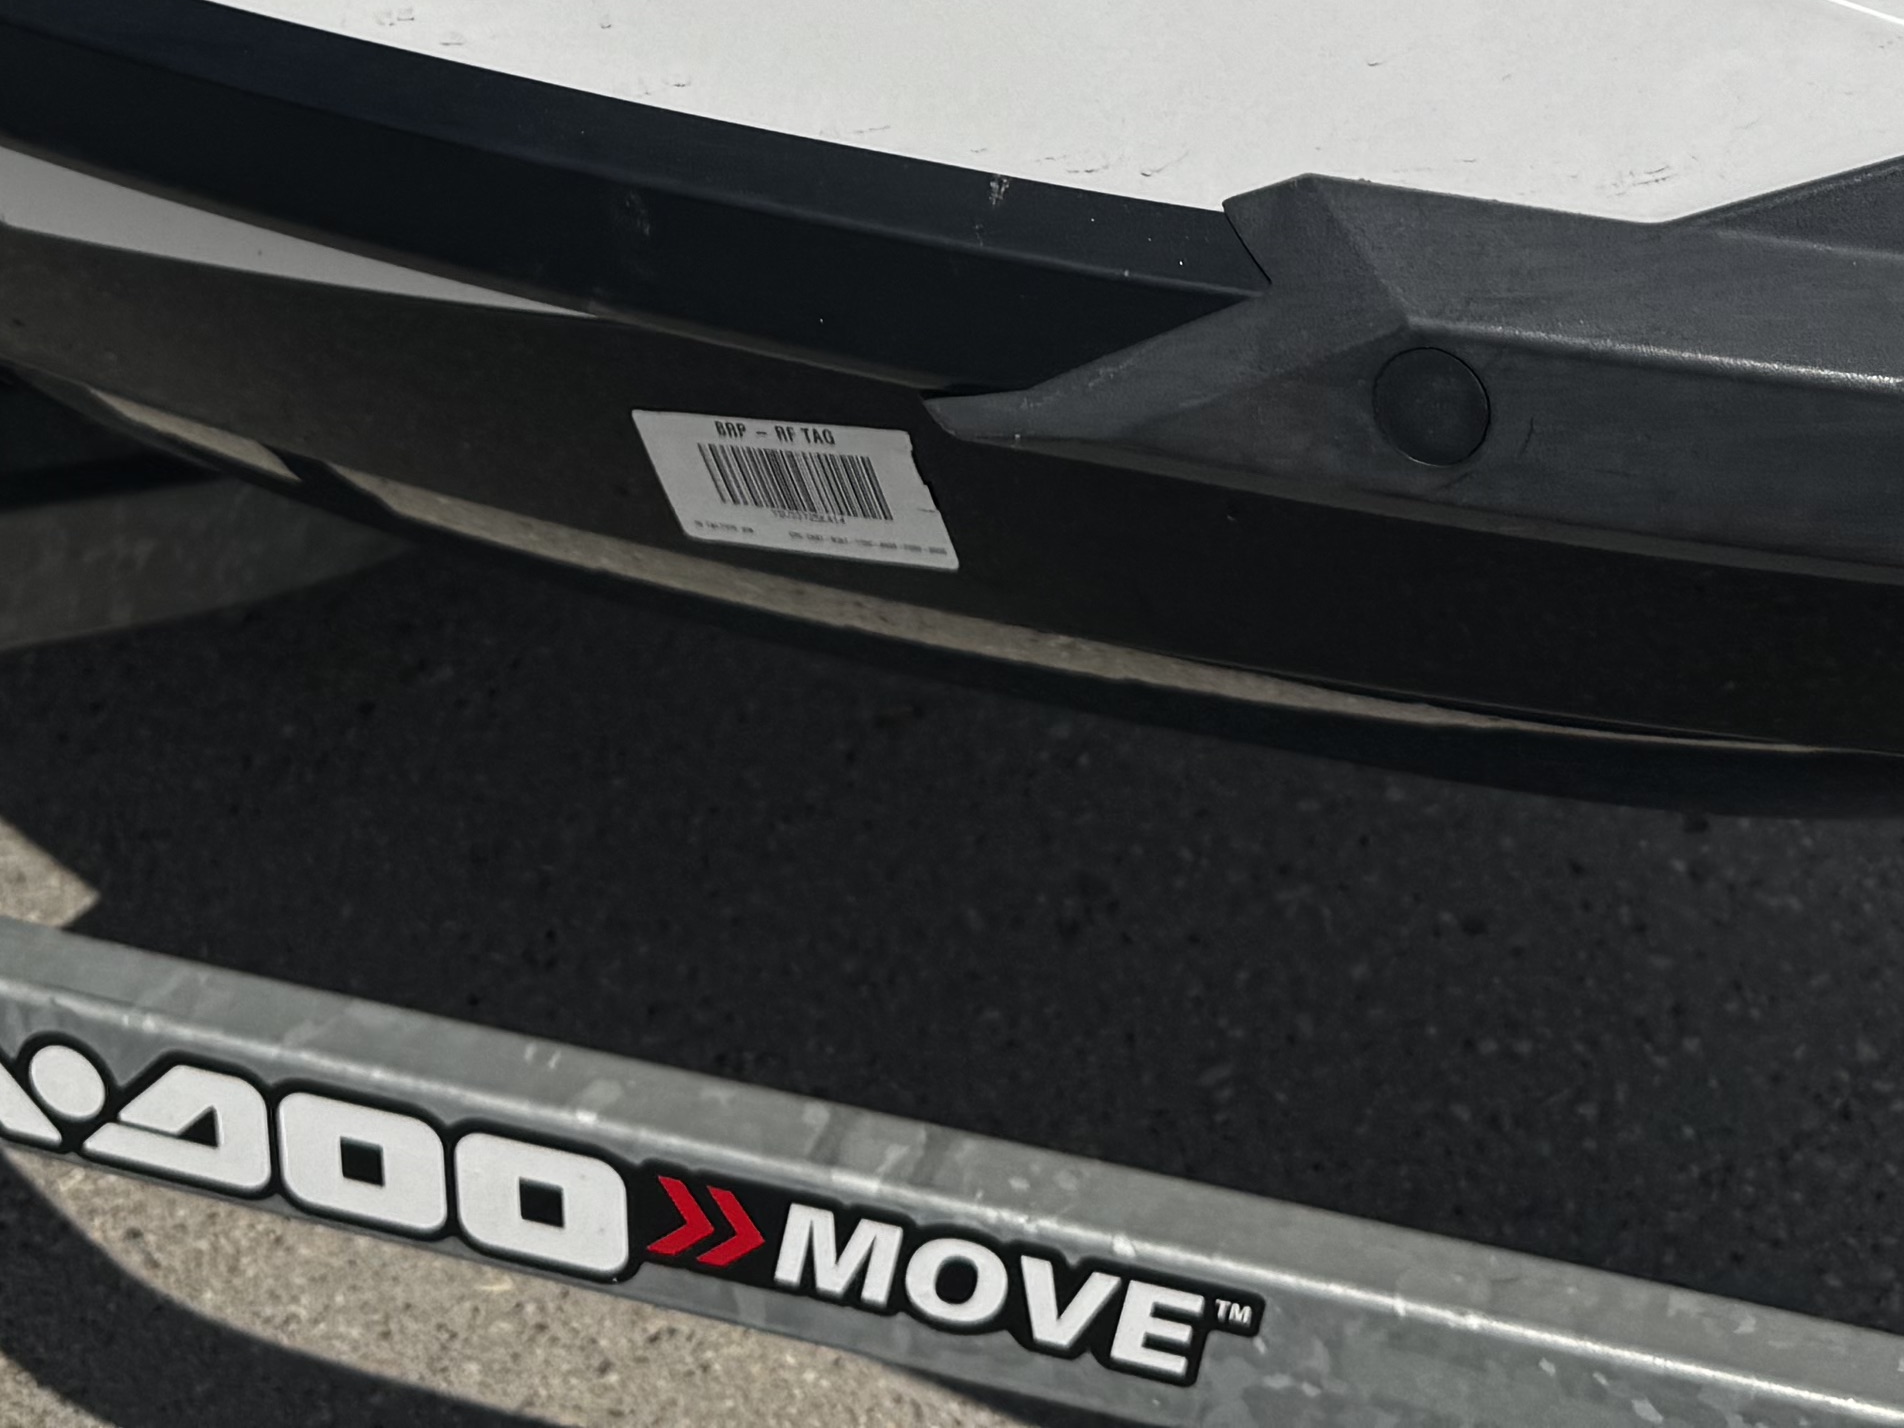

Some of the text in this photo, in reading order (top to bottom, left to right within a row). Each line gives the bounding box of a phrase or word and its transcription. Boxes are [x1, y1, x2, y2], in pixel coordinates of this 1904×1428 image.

[714, 420, 746, 438] BRP
[800, 427, 836, 445] TAG
[773, 1201, 1205, 1378] MOVE
